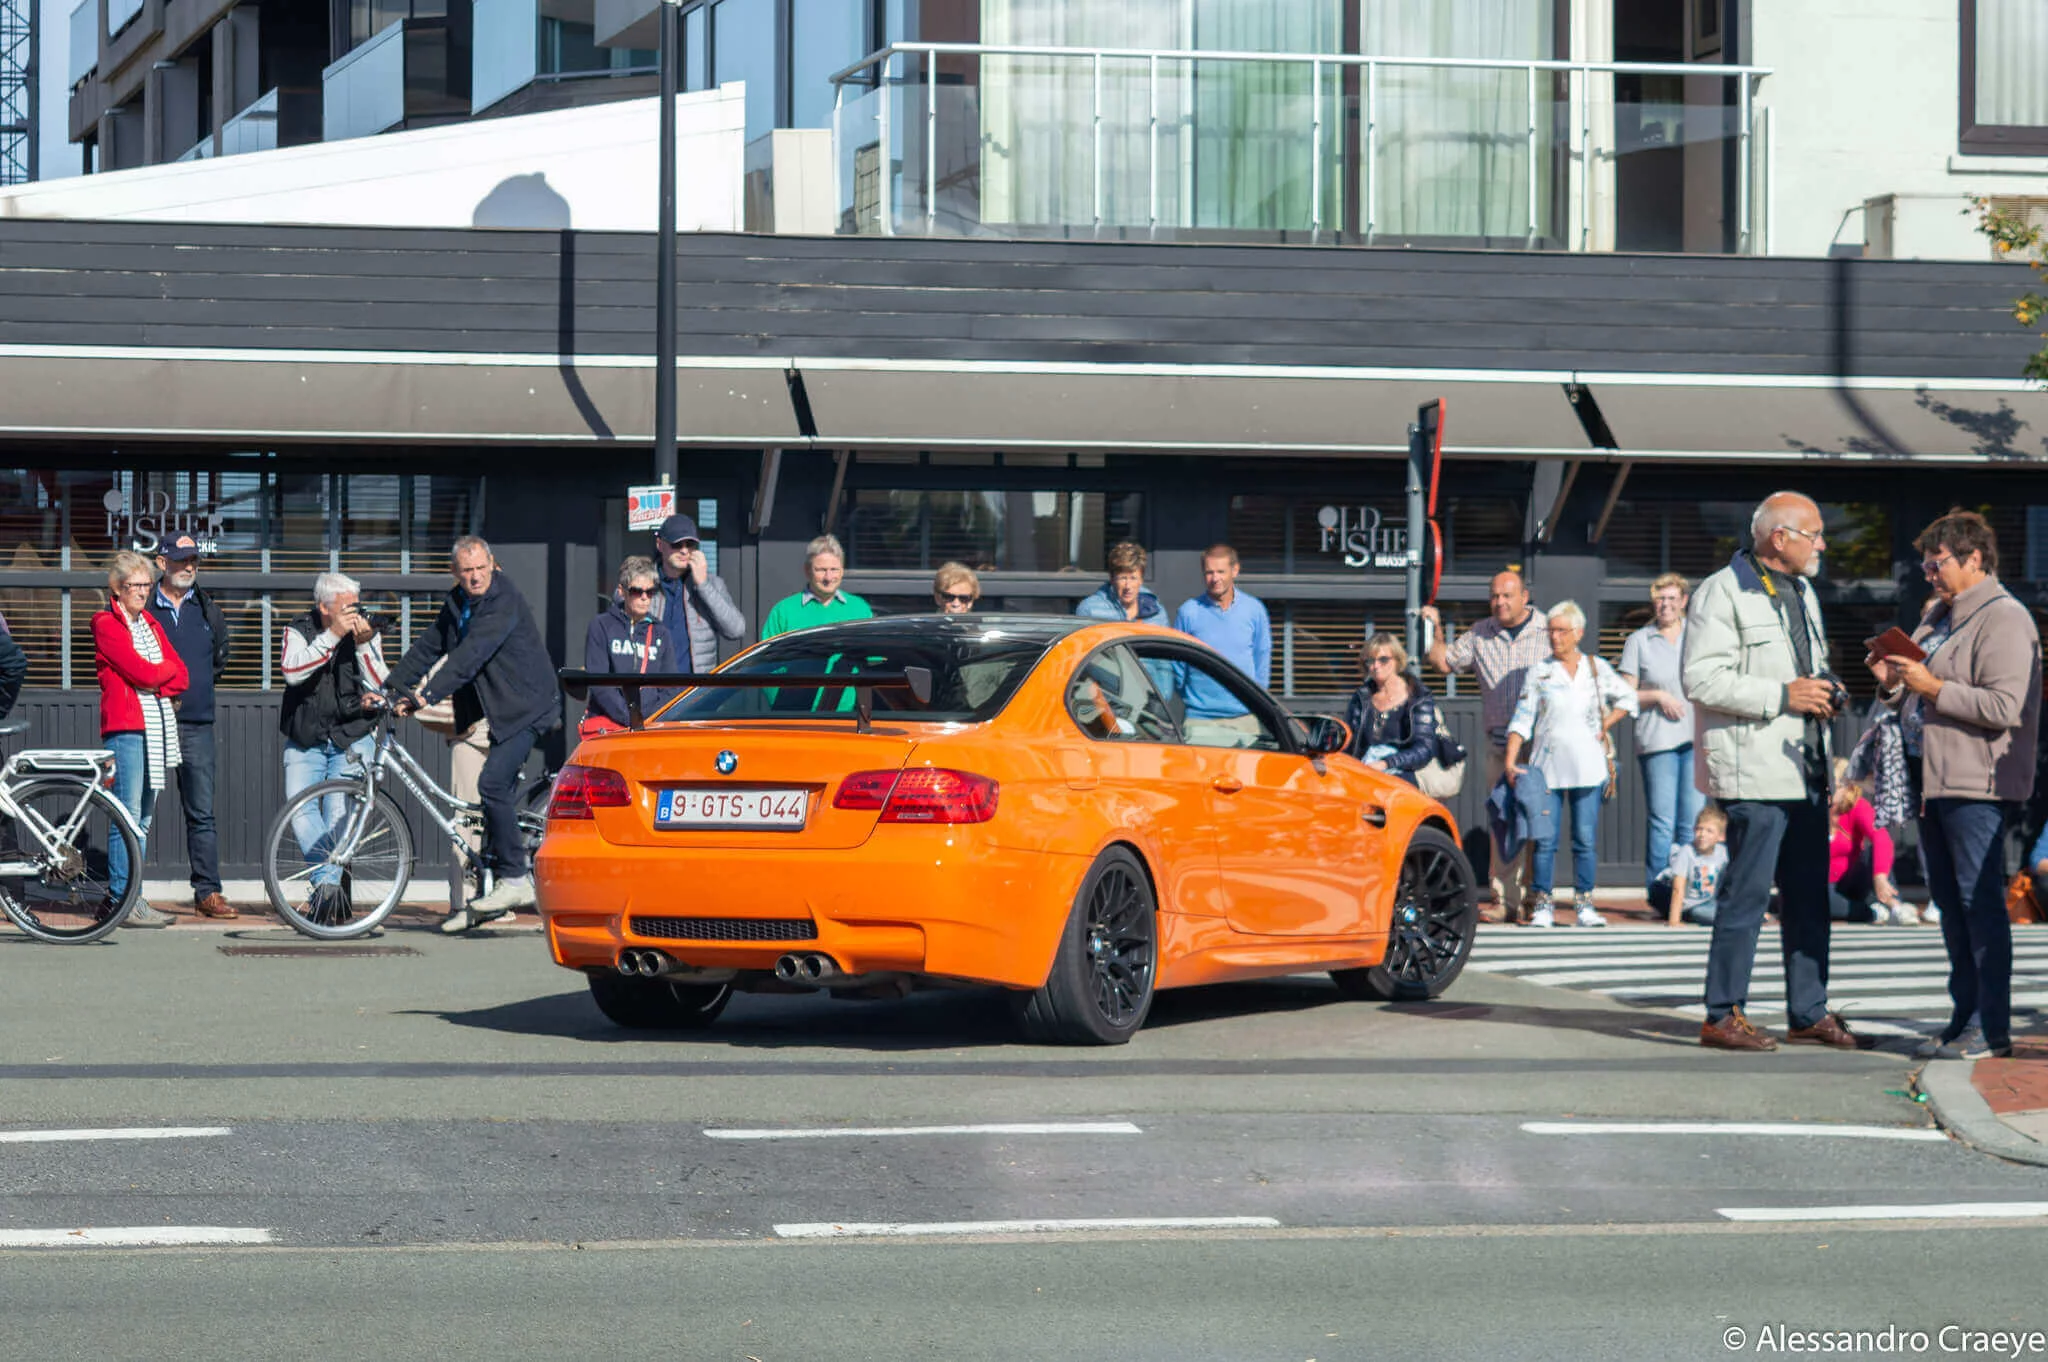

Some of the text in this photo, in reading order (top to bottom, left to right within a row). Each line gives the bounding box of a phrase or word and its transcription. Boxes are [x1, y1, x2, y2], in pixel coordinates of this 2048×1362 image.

[1320, 528, 1408, 567] FISHE
[1375, 553, 1408, 567] BRASS
[660, 806, 670, 819] B
